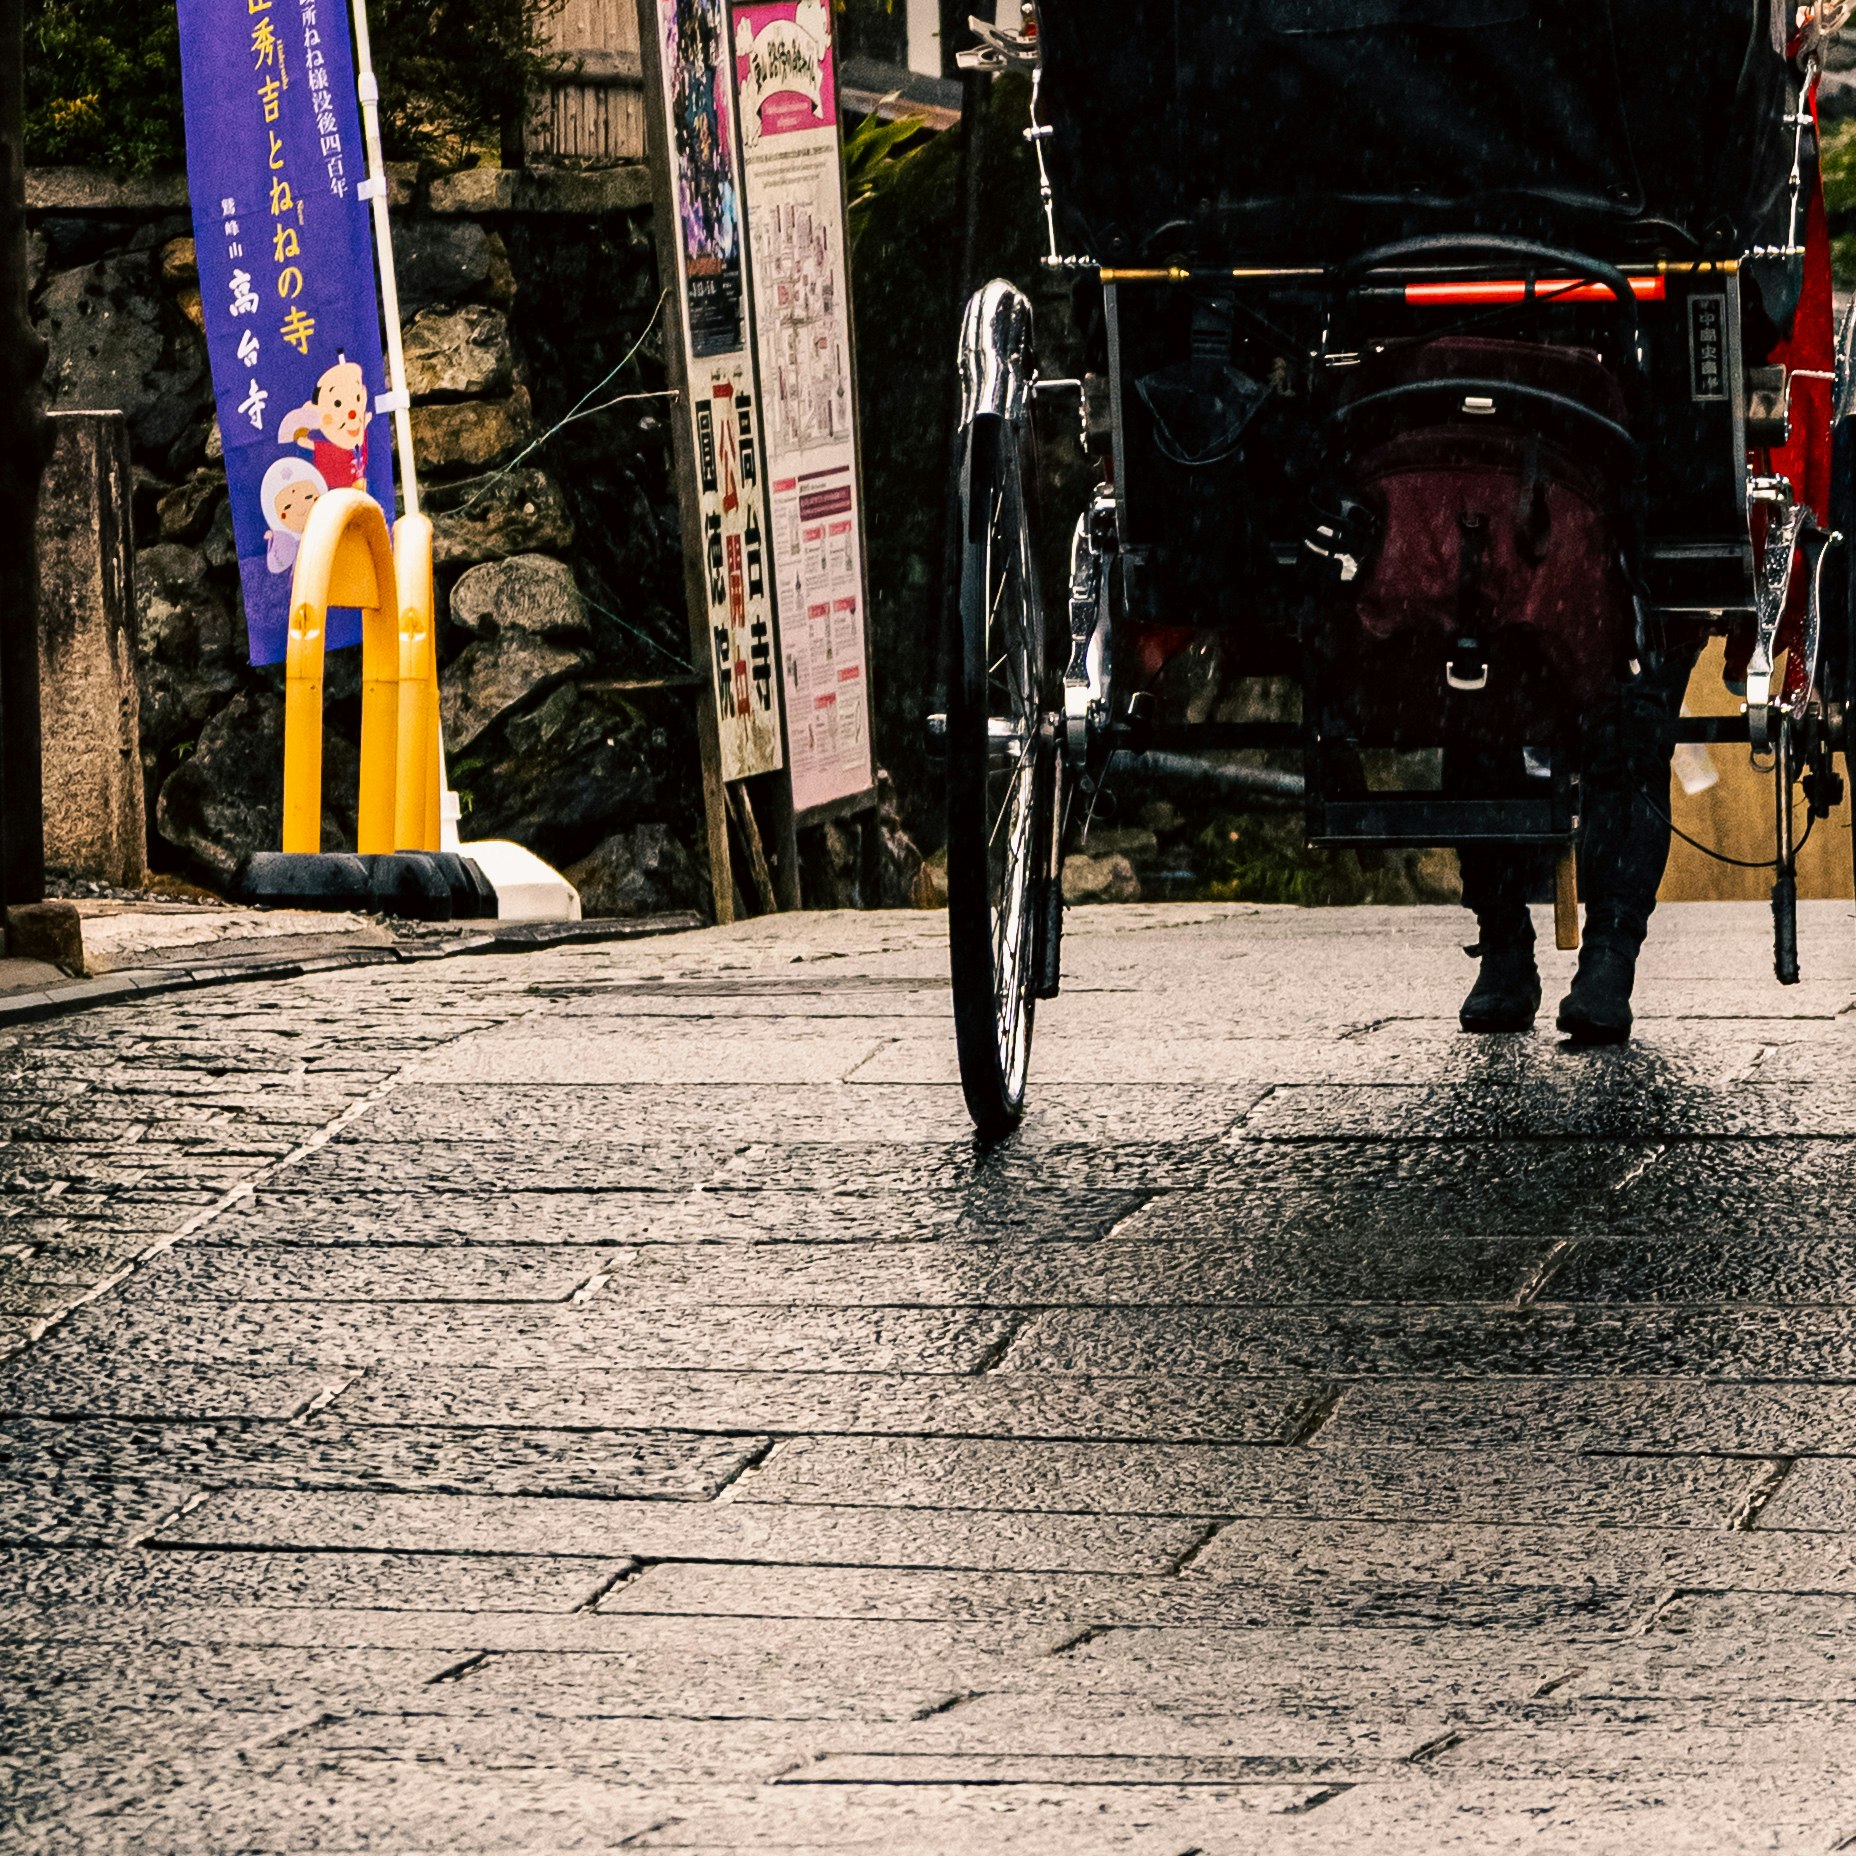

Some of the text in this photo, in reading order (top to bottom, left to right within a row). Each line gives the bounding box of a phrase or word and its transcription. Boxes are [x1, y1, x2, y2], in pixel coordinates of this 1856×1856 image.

[228, 268, 268, 431] 高台寺
[719, 419, 749, 743] 公開中
[735, 391, 771, 711] 高台寺
